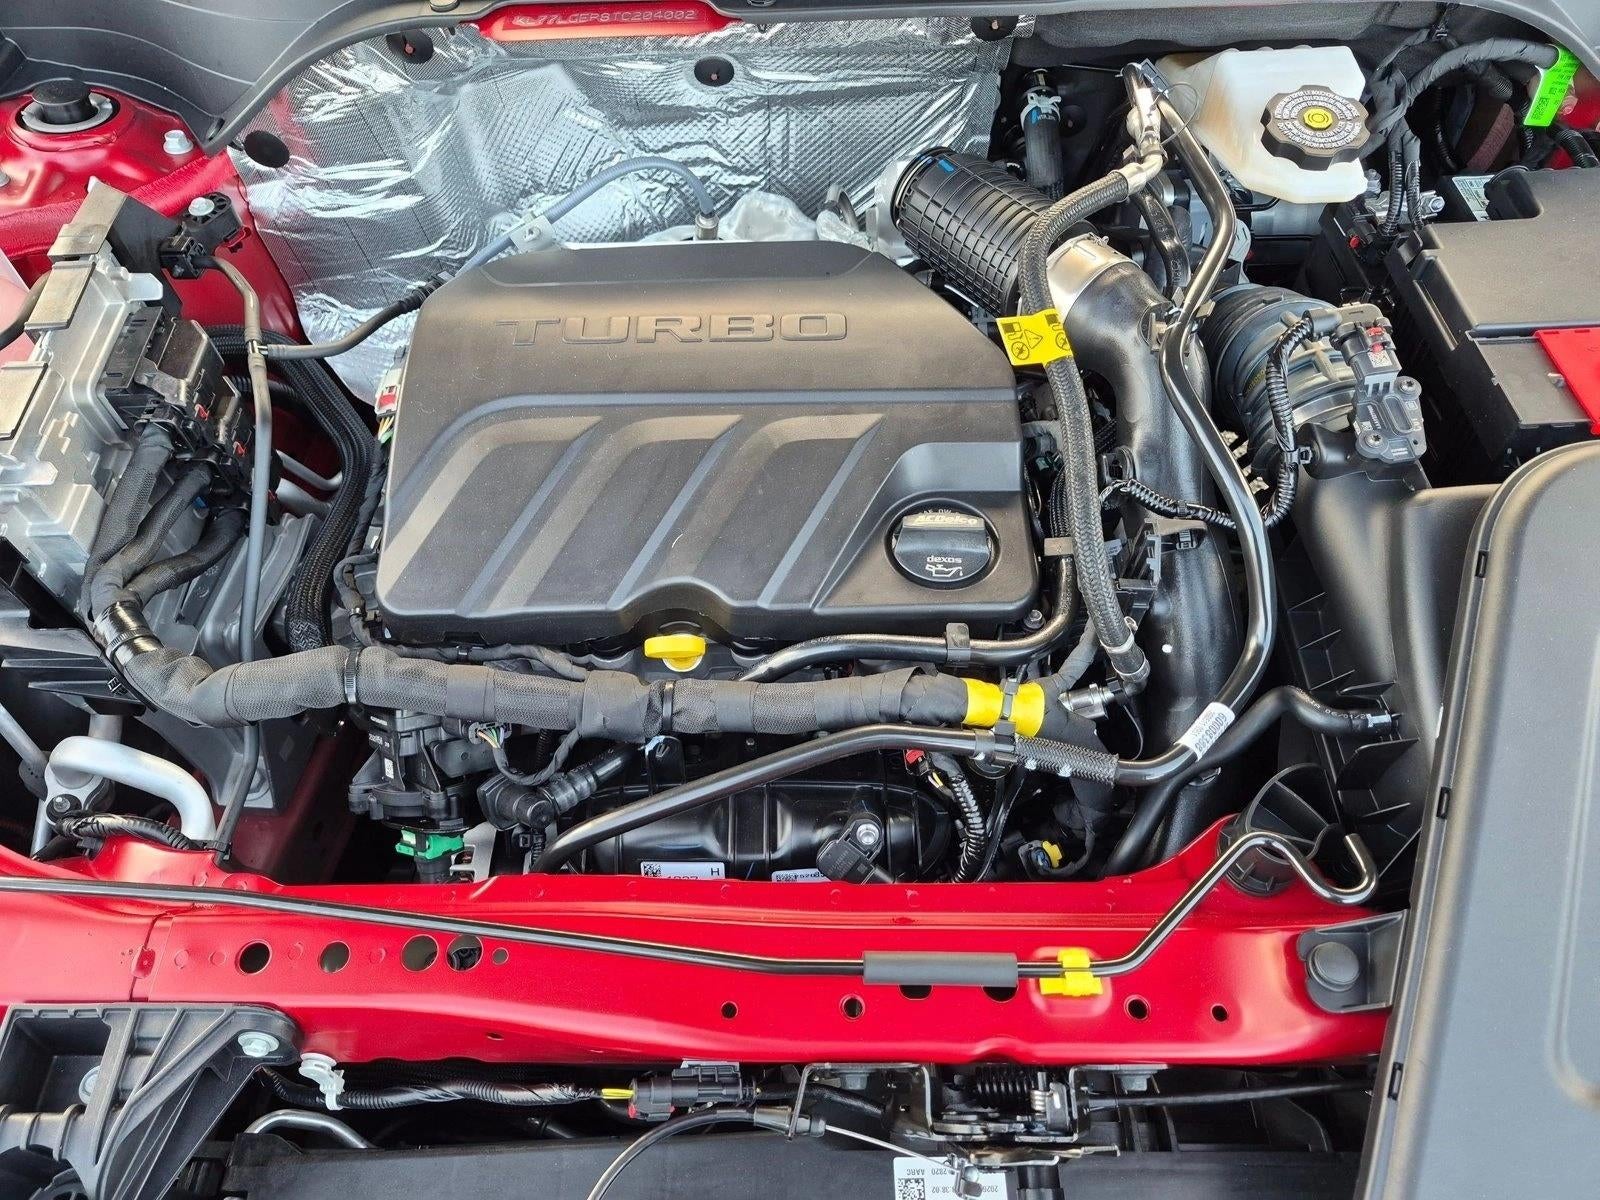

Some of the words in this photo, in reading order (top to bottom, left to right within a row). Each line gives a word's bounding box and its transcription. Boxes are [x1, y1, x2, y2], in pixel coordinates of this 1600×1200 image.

[495, 313, 847, 346] TURBO
[926, 555, 962, 564] dexos
[710, 867, 720, 876] H
